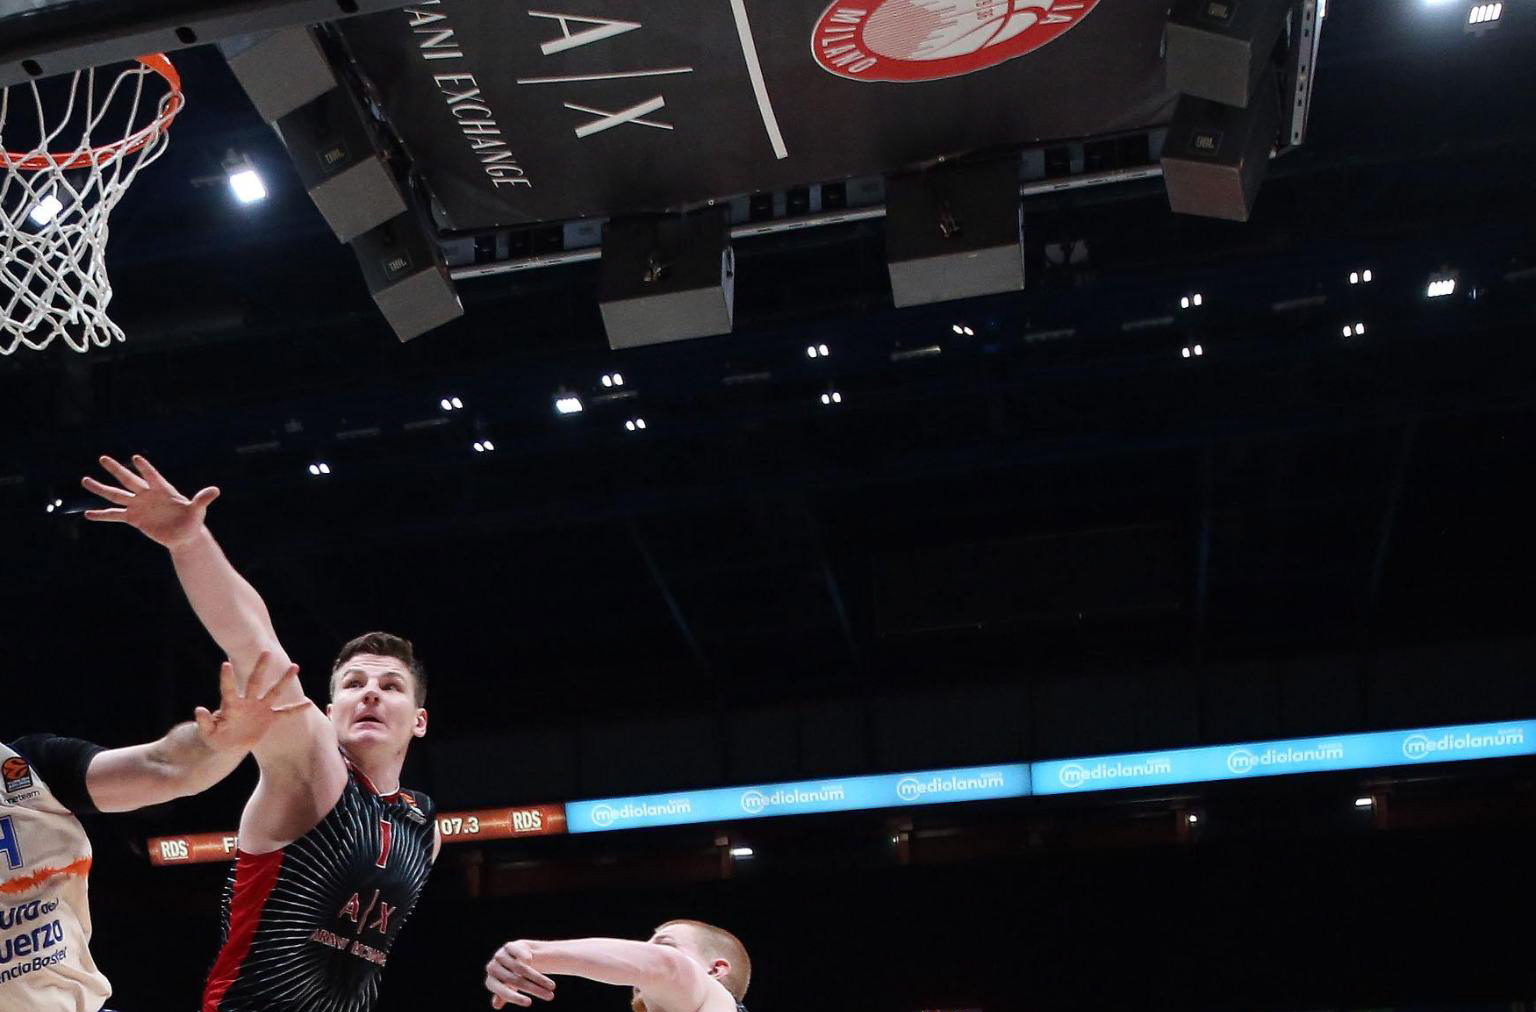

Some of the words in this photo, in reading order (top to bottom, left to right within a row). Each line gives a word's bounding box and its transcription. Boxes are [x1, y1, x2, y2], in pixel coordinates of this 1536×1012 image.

[822, 8, 877, 74] MILANO
[433, 72, 532, 189] EXCHANGE
[1402, 731, 1524, 759] mediolanum
[1059, 759, 1171, 788] mediolanum
[1227, 745, 1344, 774] mediolanum
[741, 788, 845, 814] mediolanum
[896, 774, 1004, 801] mediolanum
[512, 810, 544, 831] RDS
[591, 801, 692, 827] mediolanum
[160, 839, 189, 859] RDS
[375, 819, 392, 869] 1
